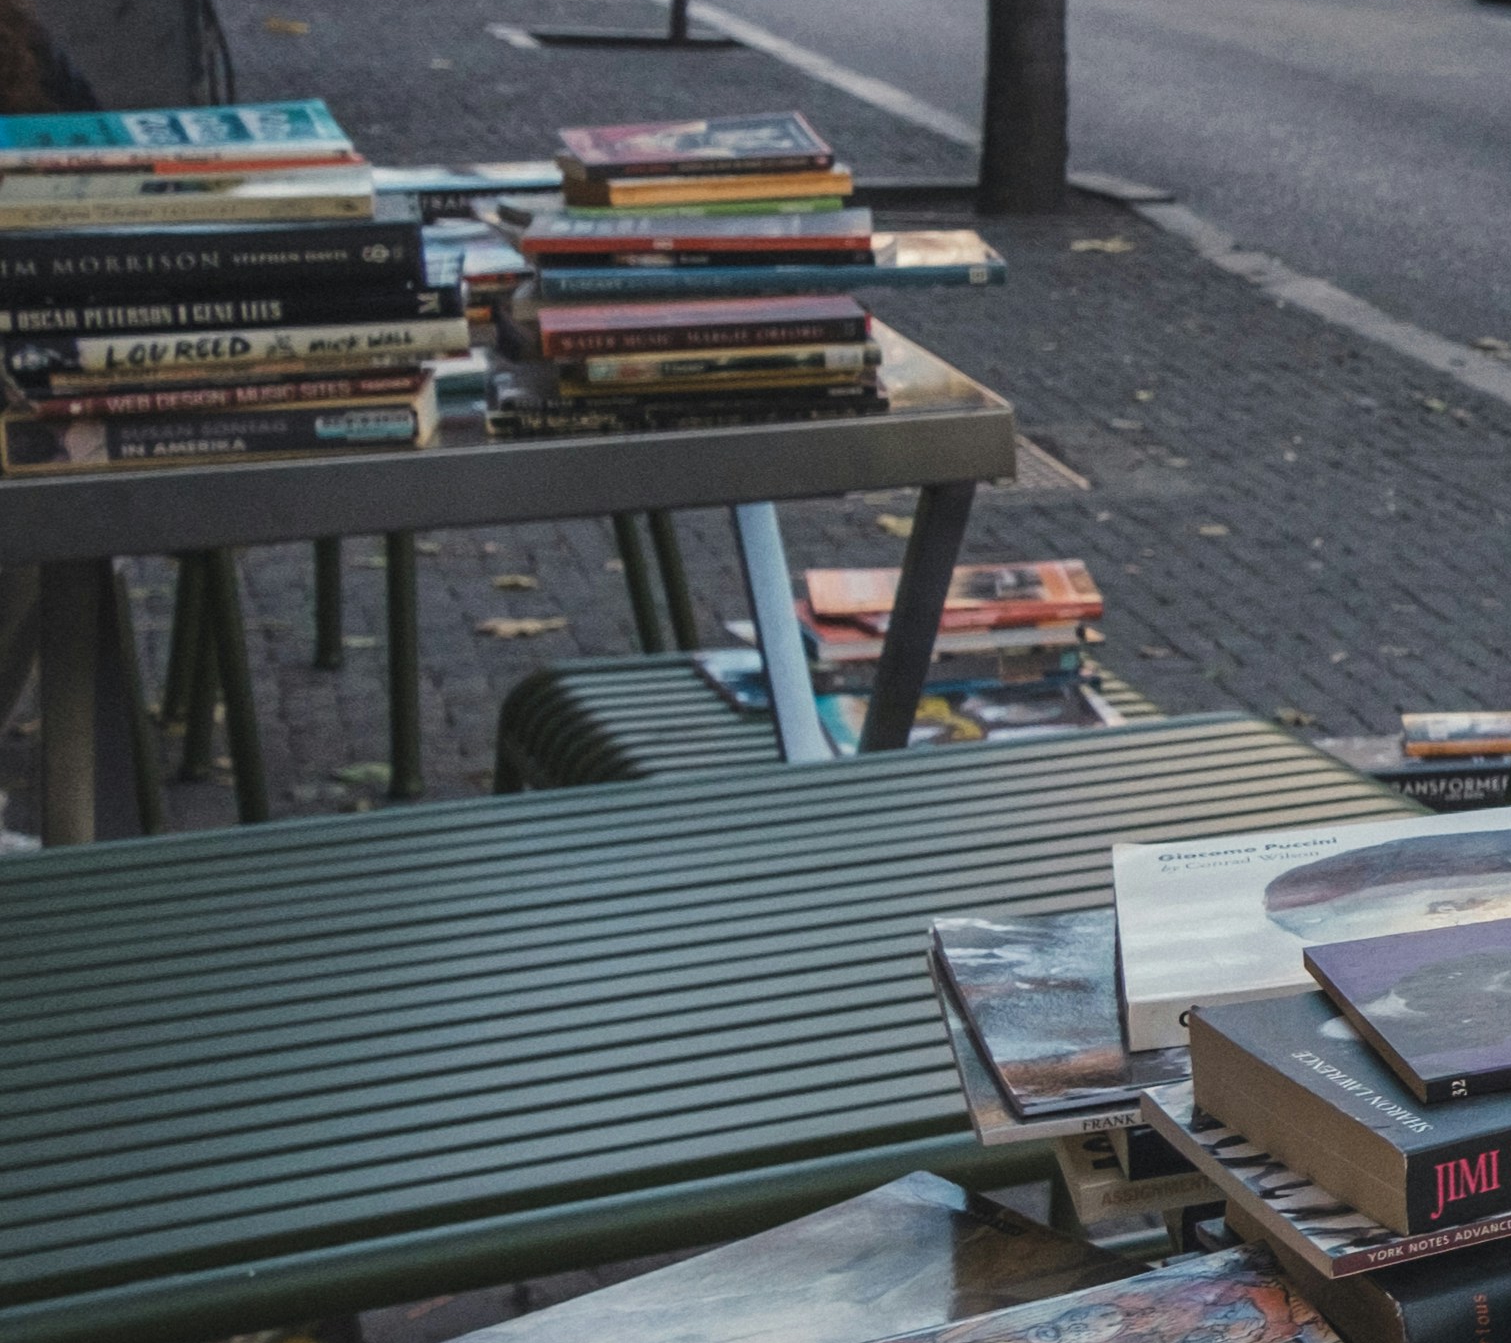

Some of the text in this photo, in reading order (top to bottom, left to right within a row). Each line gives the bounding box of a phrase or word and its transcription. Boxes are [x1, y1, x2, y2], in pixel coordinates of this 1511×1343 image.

[53, 251, 219, 275] MORRISON
[1158, 837, 1338, 863] Giacomo Puccini
[1186, 849, 1320, 872] Conrad Wilson
[1082, 1113, 1137, 1132] FRANK
[1431, 1148, 1500, 1220] JIMI
[1367, 1245, 1405, 1263] YORK
[1408, 1234, 1451, 1254] NOTES
